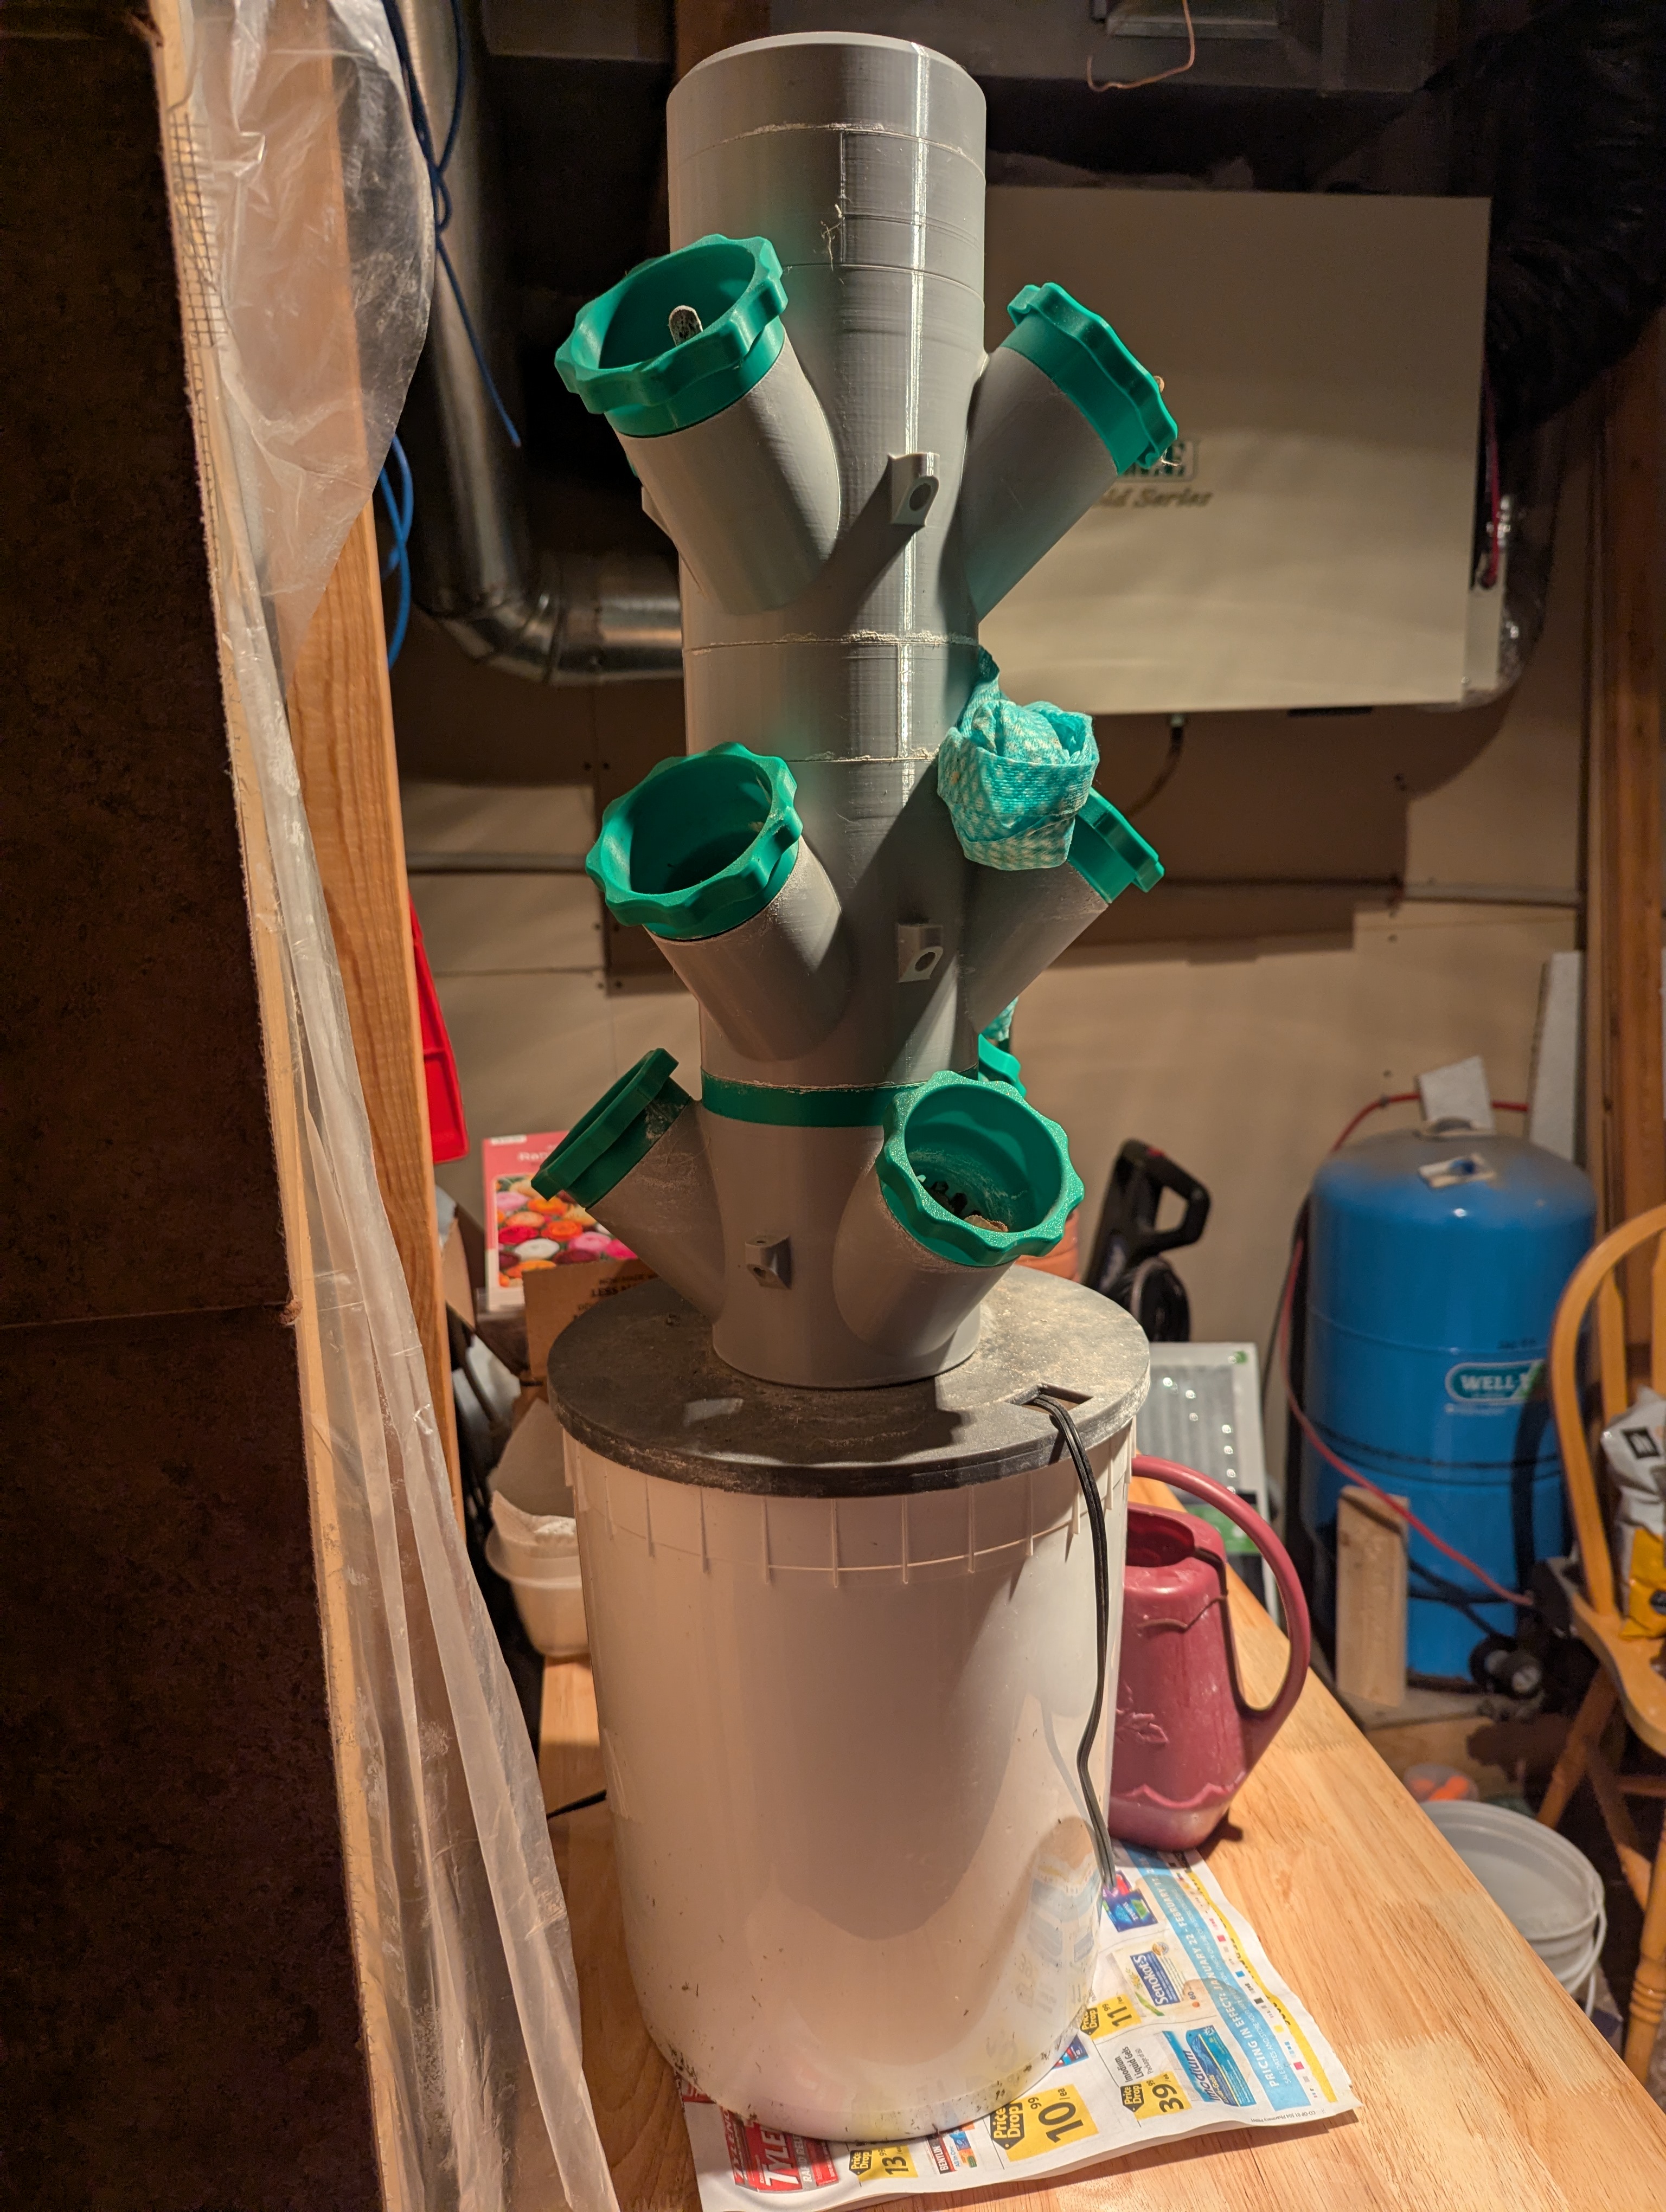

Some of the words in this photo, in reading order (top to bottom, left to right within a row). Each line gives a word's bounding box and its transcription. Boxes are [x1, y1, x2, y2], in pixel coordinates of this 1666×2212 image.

[1158, 1887, 1187, 1927] FEBRUARY
[1186, 1933, 1197, 1946] 22
[1193, 1946, 1223, 1992] JANUARY
[1188, 1991, 1196, 2000] 60
[1102, 2003, 1111, 2011] 99
[1107, 2006, 1132, 2027] 11
[1218, 1991, 1244, 2028] EFFECT:
[1090, 2010, 1098, 2028] Drop
[1240, 2027, 1252, 2039] IN
[1253, 2021, 1265, 2038] STORE
[1122, 2046, 1133, 2060] Gels
[1263, 2037, 1273, 2050] AND
[1114, 2056, 1133, 2082] Imodium
[1127, 2058, 1144, 2079] Liquid
[1142, 2057, 1154, 2074] Package
[1247, 2040, 1280, 2088] PRICING
[1268, 2050, 1283, 2070] DATES
[1183, 2050, 1221, 2101] Imodium
[1279, 2069, 1291, 2084] SALE
[1028, 2097, 1042, 2110] 99
[1132, 2085, 1142, 2104] Drop
[1152, 2084, 1184, 2112] 39
[1007, 2105, 1023, 2138] Drop
[1038, 2102, 1084, 2143] 10
[723, 2110, 744, 2179] TYLENO
[878, 2147, 887, 2156] 99
[760, 2126, 799, 2187] TYLE
[860, 2151, 872, 2169] Drop
[882, 2156, 909, 2175] 13
[932, 2145, 949, 2171] BENYLIN
